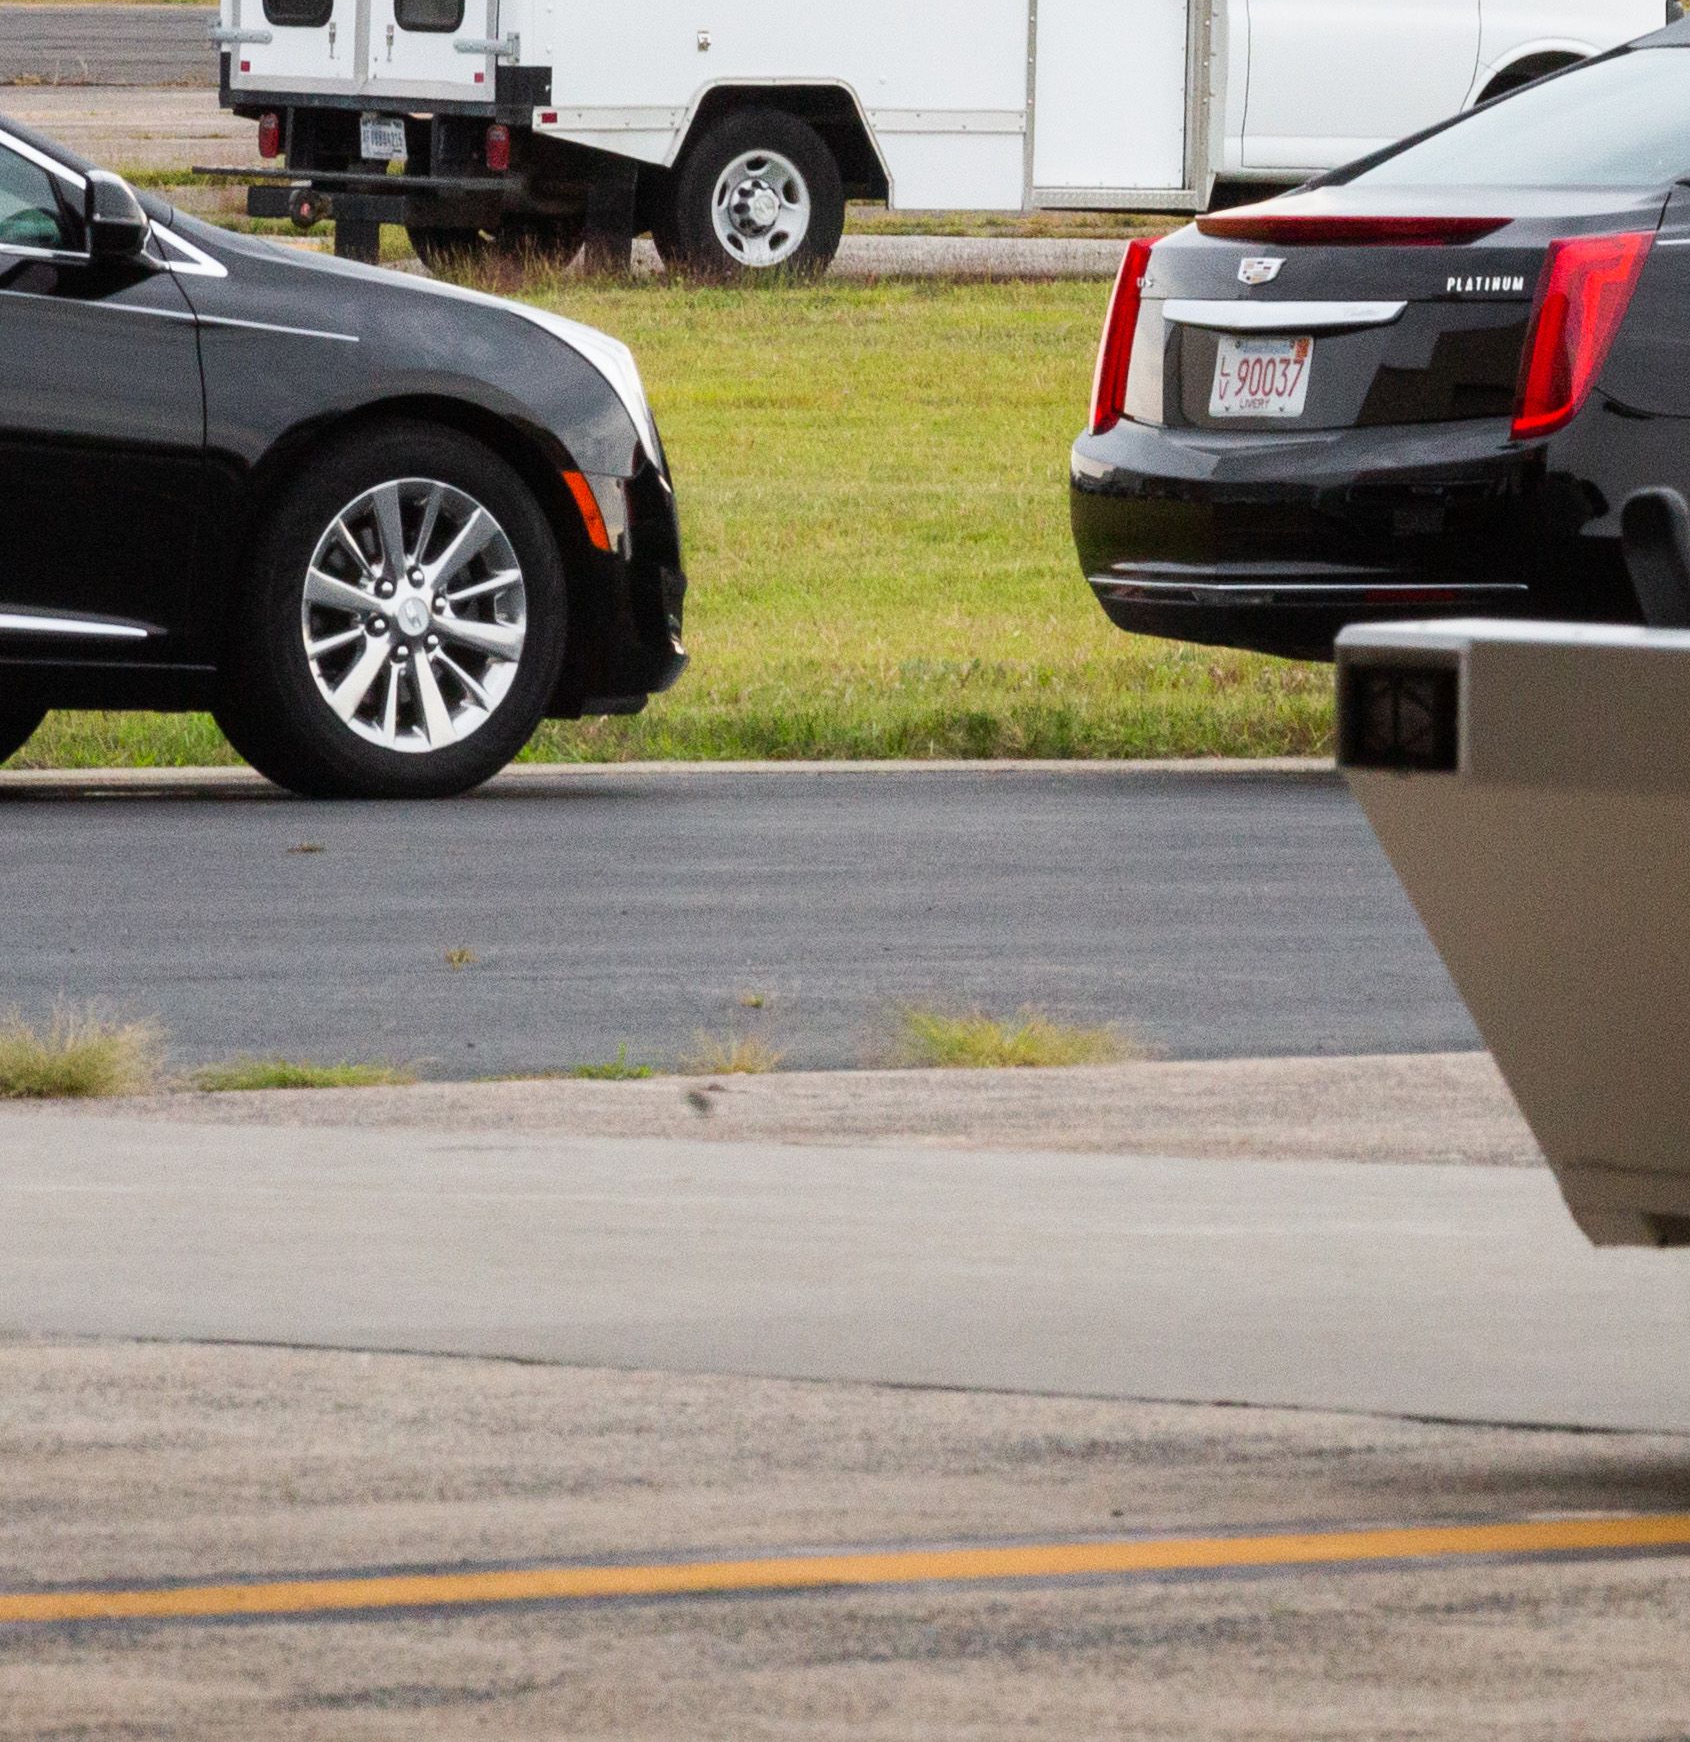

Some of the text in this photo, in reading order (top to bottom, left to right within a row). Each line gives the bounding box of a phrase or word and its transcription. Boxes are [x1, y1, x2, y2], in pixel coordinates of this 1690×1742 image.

[1446, 276, 1525, 292] PLATINUM
[1234, 357, 1304, 397] 90037
[1240, 398, 1271, 410] LIVERY
